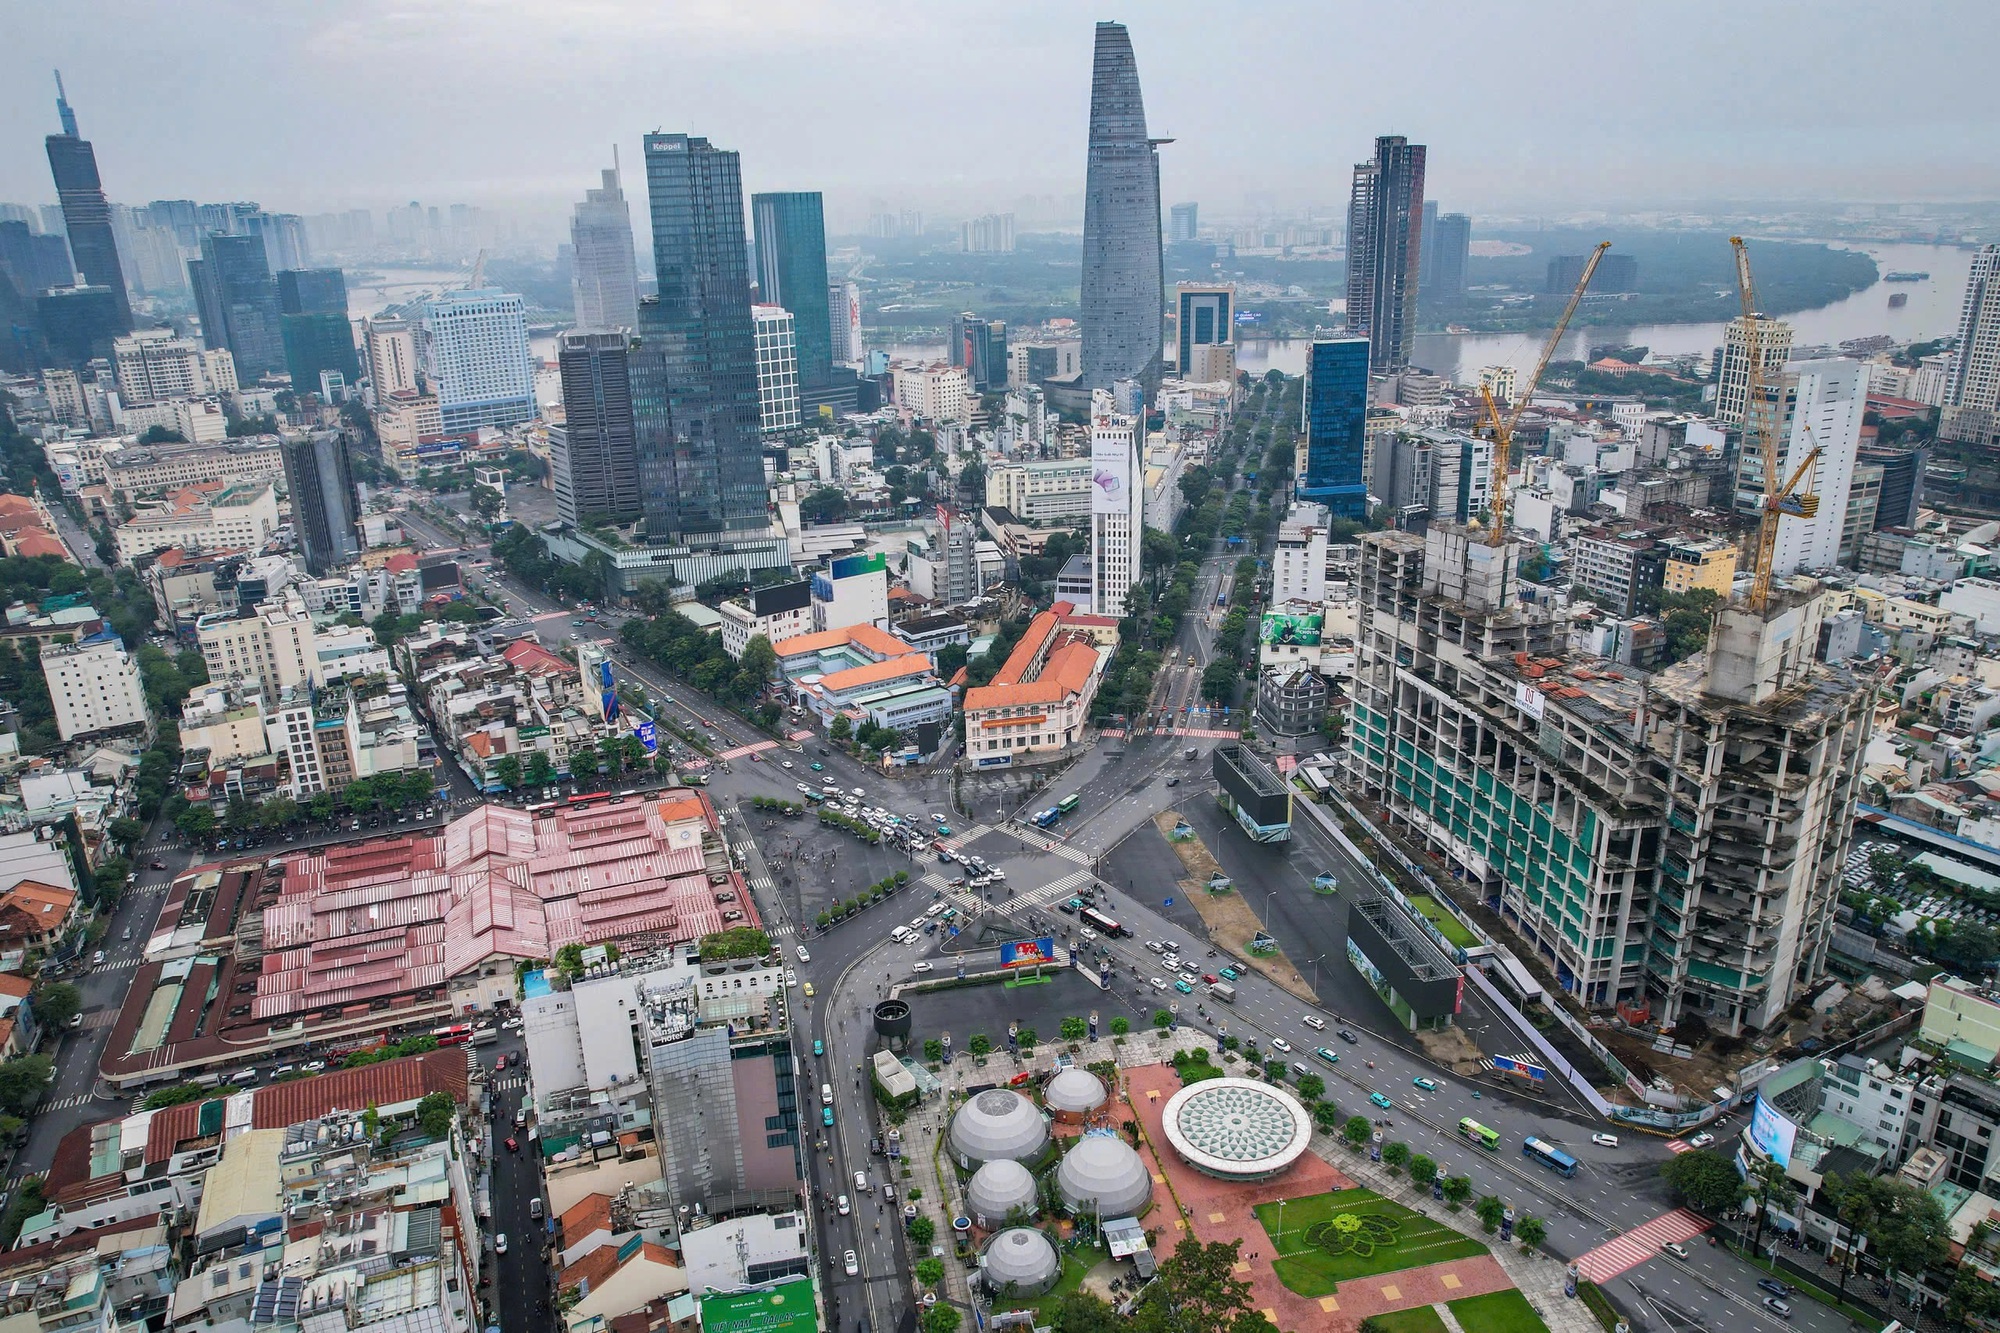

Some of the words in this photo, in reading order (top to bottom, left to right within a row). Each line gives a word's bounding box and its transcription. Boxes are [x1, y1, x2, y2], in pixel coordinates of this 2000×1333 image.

[653, 143, 681, 151] Keppel
[1112, 418, 1127, 426] MB
[762, 1311, 795, 1325] DALLAS
